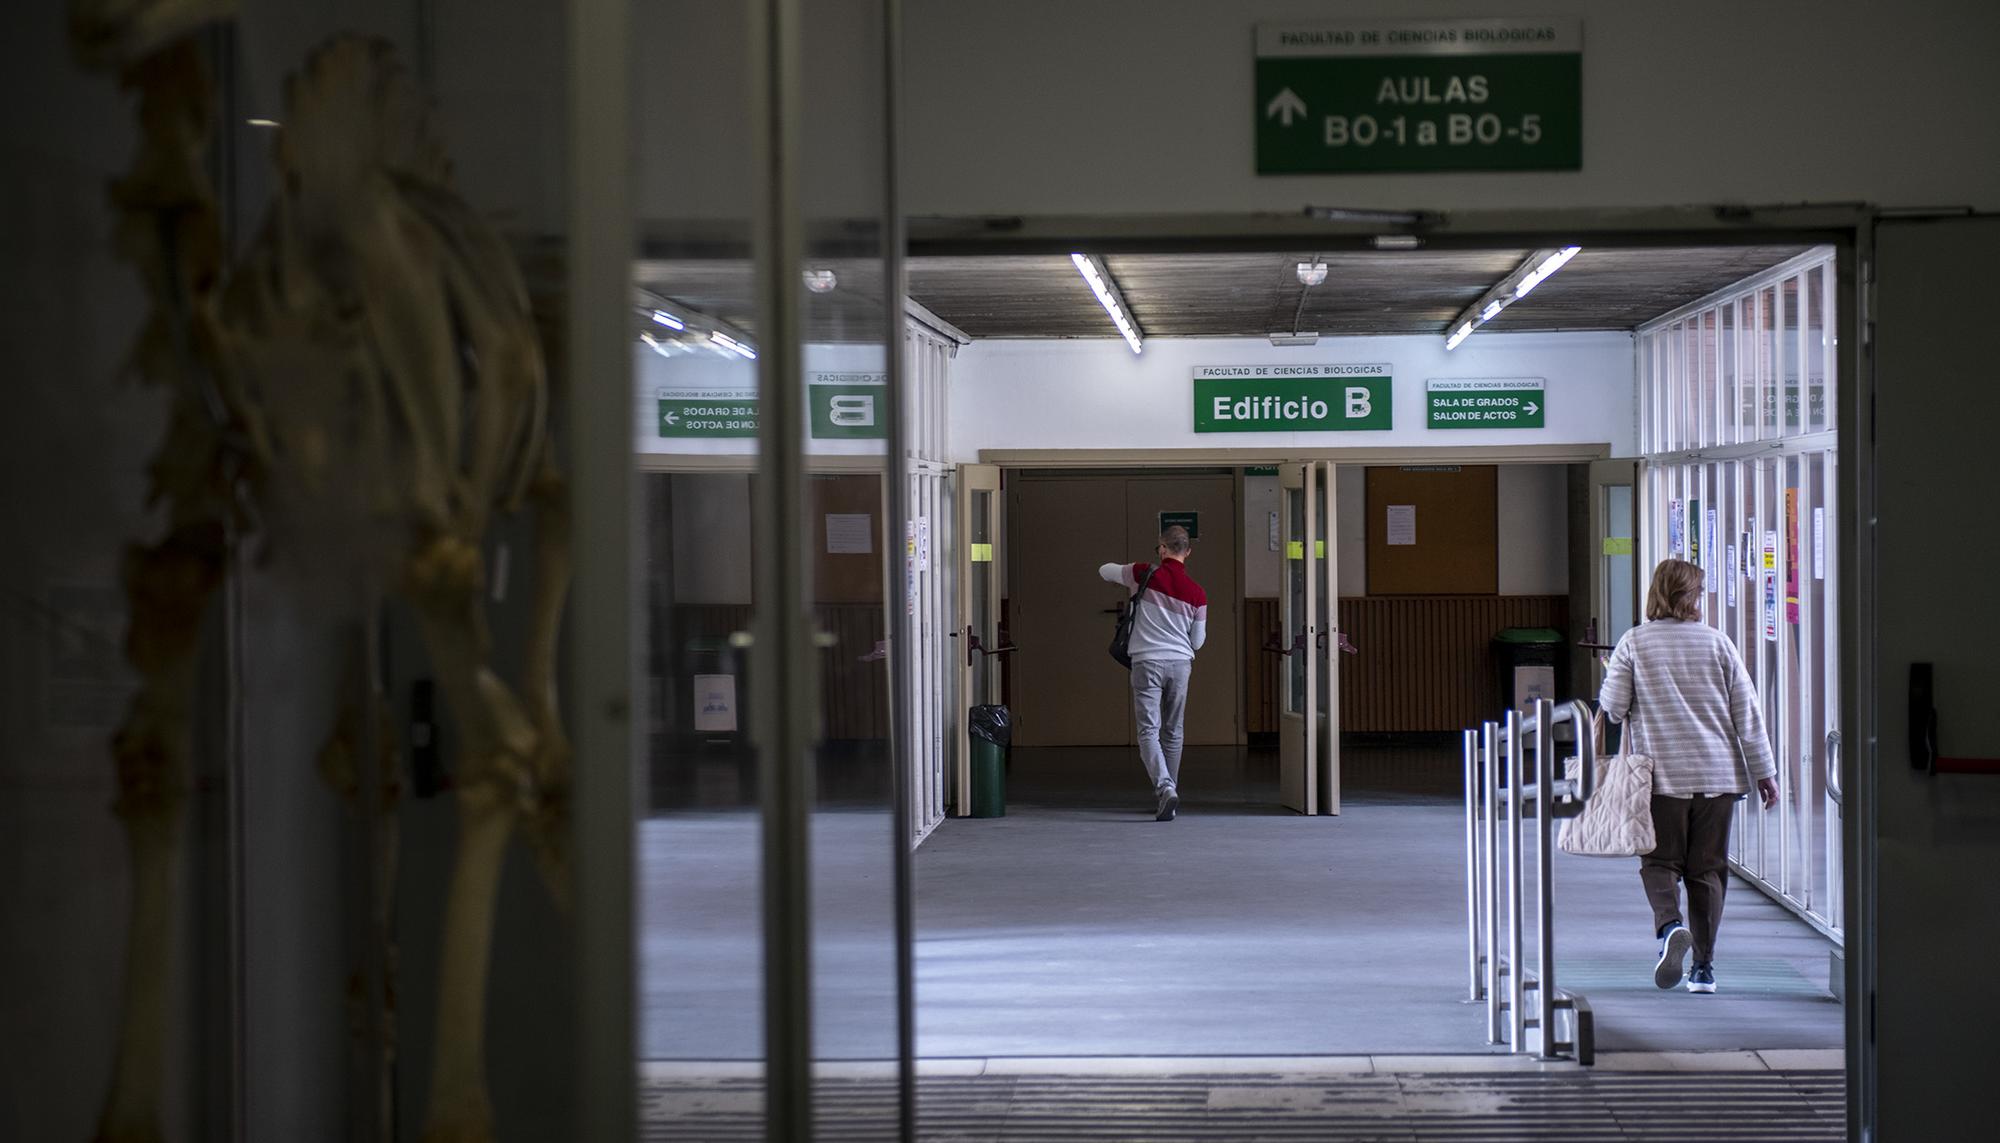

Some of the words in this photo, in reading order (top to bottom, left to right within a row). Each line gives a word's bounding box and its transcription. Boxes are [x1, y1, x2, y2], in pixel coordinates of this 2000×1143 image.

[1280, 31, 1354, 46] FACULTAD
[1361, 31, 1380, 44] DE
[1388, 29, 1458, 43] CIENCIAS
[1464, 27, 1556, 42] BIOLOGICAS
[1377, 75, 1489, 105] AULAS
[1325, 114, 1407, 146] BO-1
[1417, 119, 1437, 145] a
[1449, 113, 1542, 144] BO-5
[1203, 367, 1250, 376] FACULTAD
[1256, 367, 1268, 375] DE
[1273, 366, 1319, 375] CIENCIAS
[1324, 366, 1383, 374] BIOLOGICAS
[1213, 396, 1328, 420] Edificio
[1345, 386, 1372, 418] B
[1433, 398, 1460, 407] SALA
[1461, 398, 1475, 406] DE
[1476, 397, 1519, 406] GRADOS
[1433, 411, 1466, 420] SALON
[1468, 411, 1481, 420] DE
[1483, 411, 1517, 420] ACTOS
